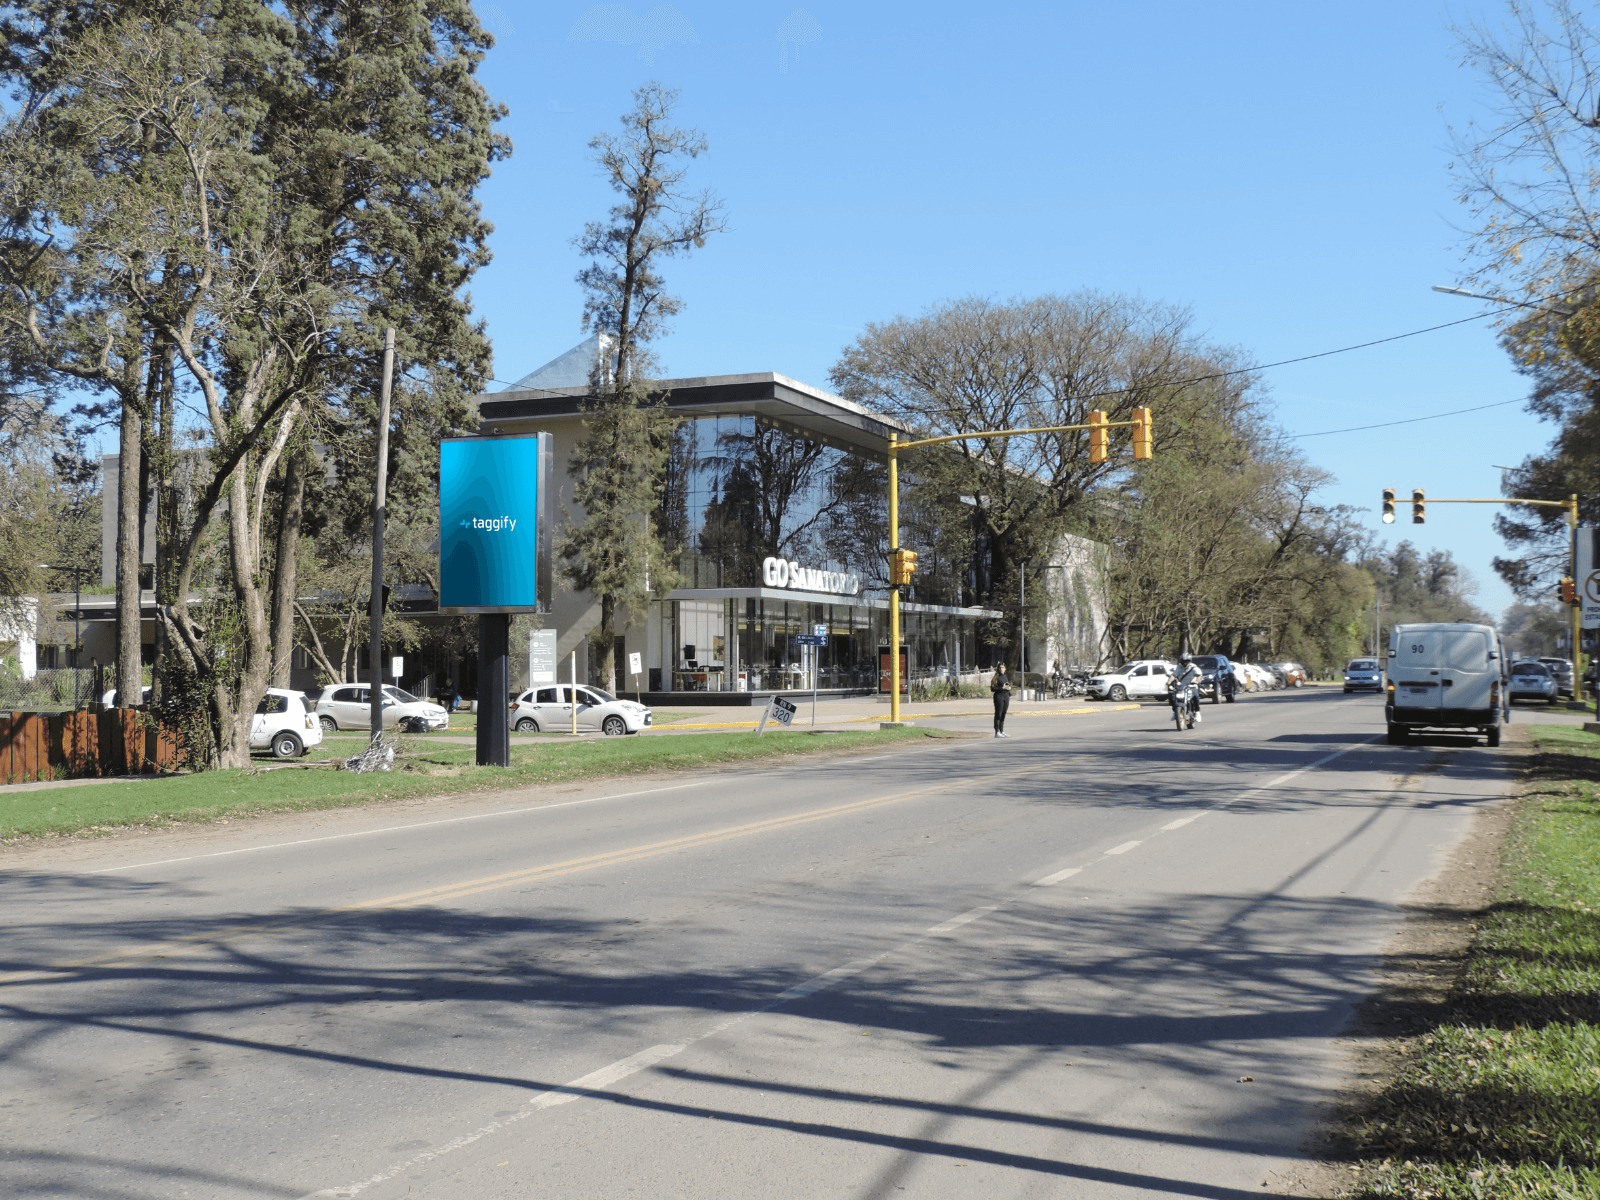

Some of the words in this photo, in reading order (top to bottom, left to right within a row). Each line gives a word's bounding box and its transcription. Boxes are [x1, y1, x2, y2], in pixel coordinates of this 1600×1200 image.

[472, 515, 517, 532] taggify
[763, 556, 789, 588] GO
[1411, 644, 1425, 654] 90
[772, 707, 790, 723] 320
[787, 703, 793, 711] 9
